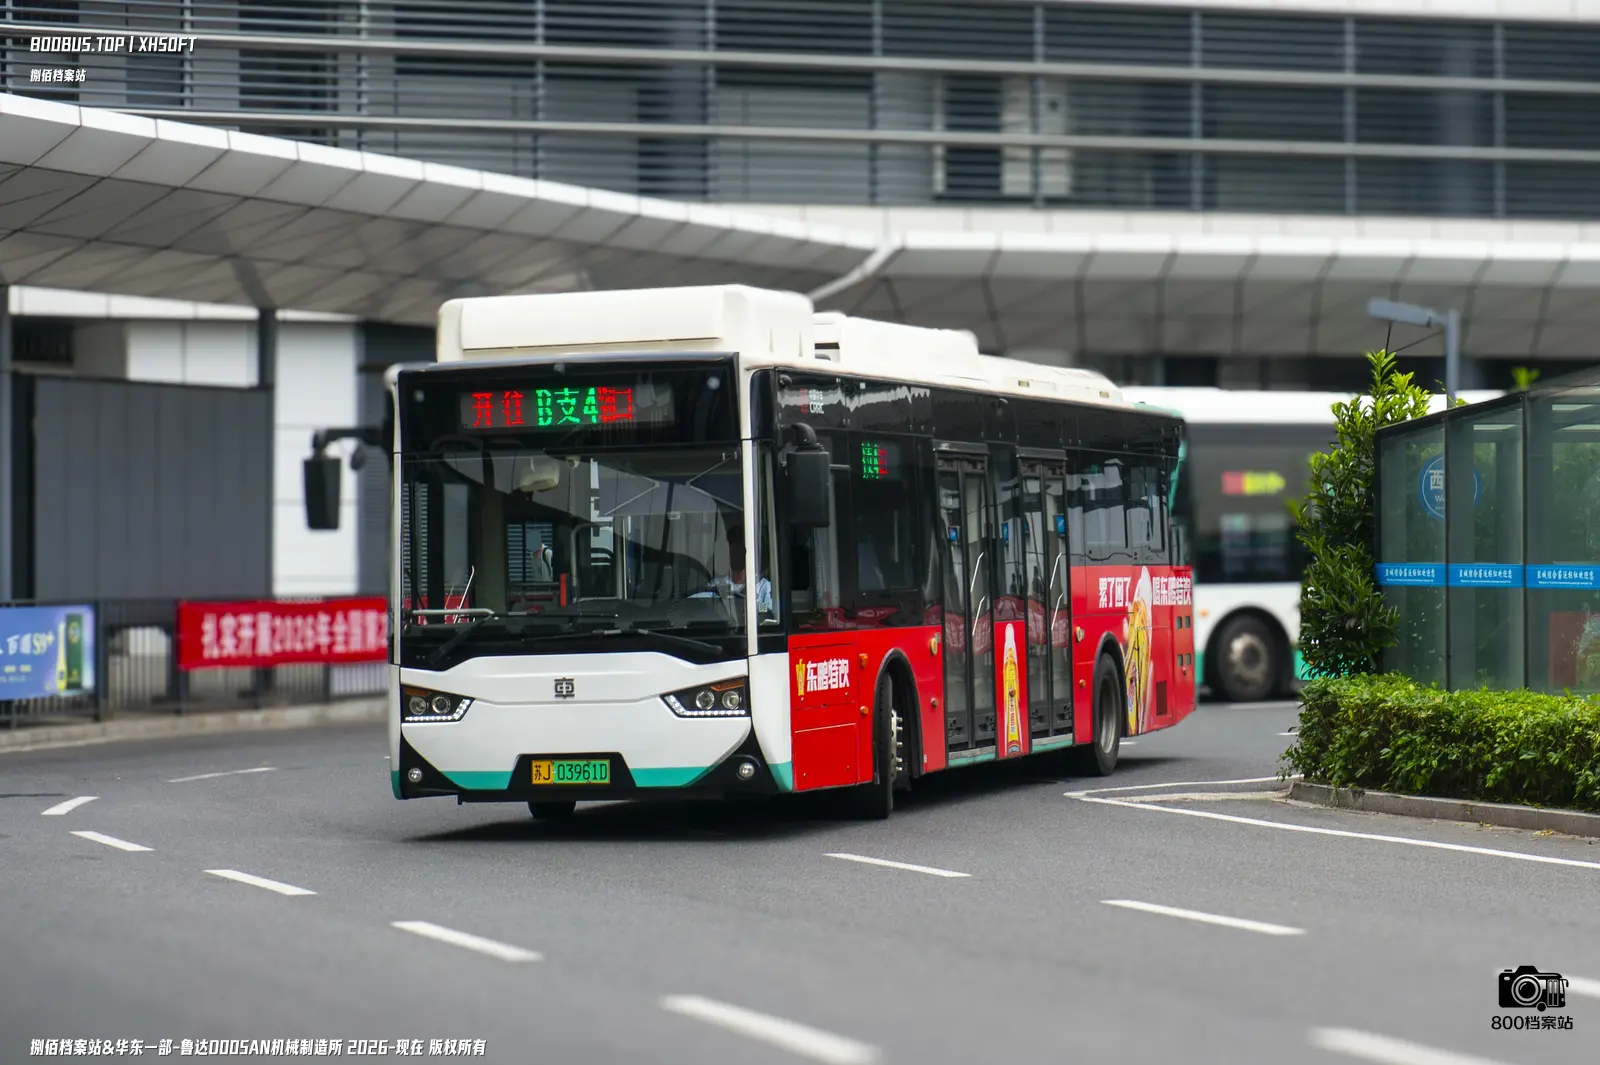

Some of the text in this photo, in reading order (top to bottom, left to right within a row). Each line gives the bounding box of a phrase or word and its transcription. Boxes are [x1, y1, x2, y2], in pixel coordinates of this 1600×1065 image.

[1099, 576, 1131, 608] 累了困了
[806, 658, 850, 693] 东鹏特饮
